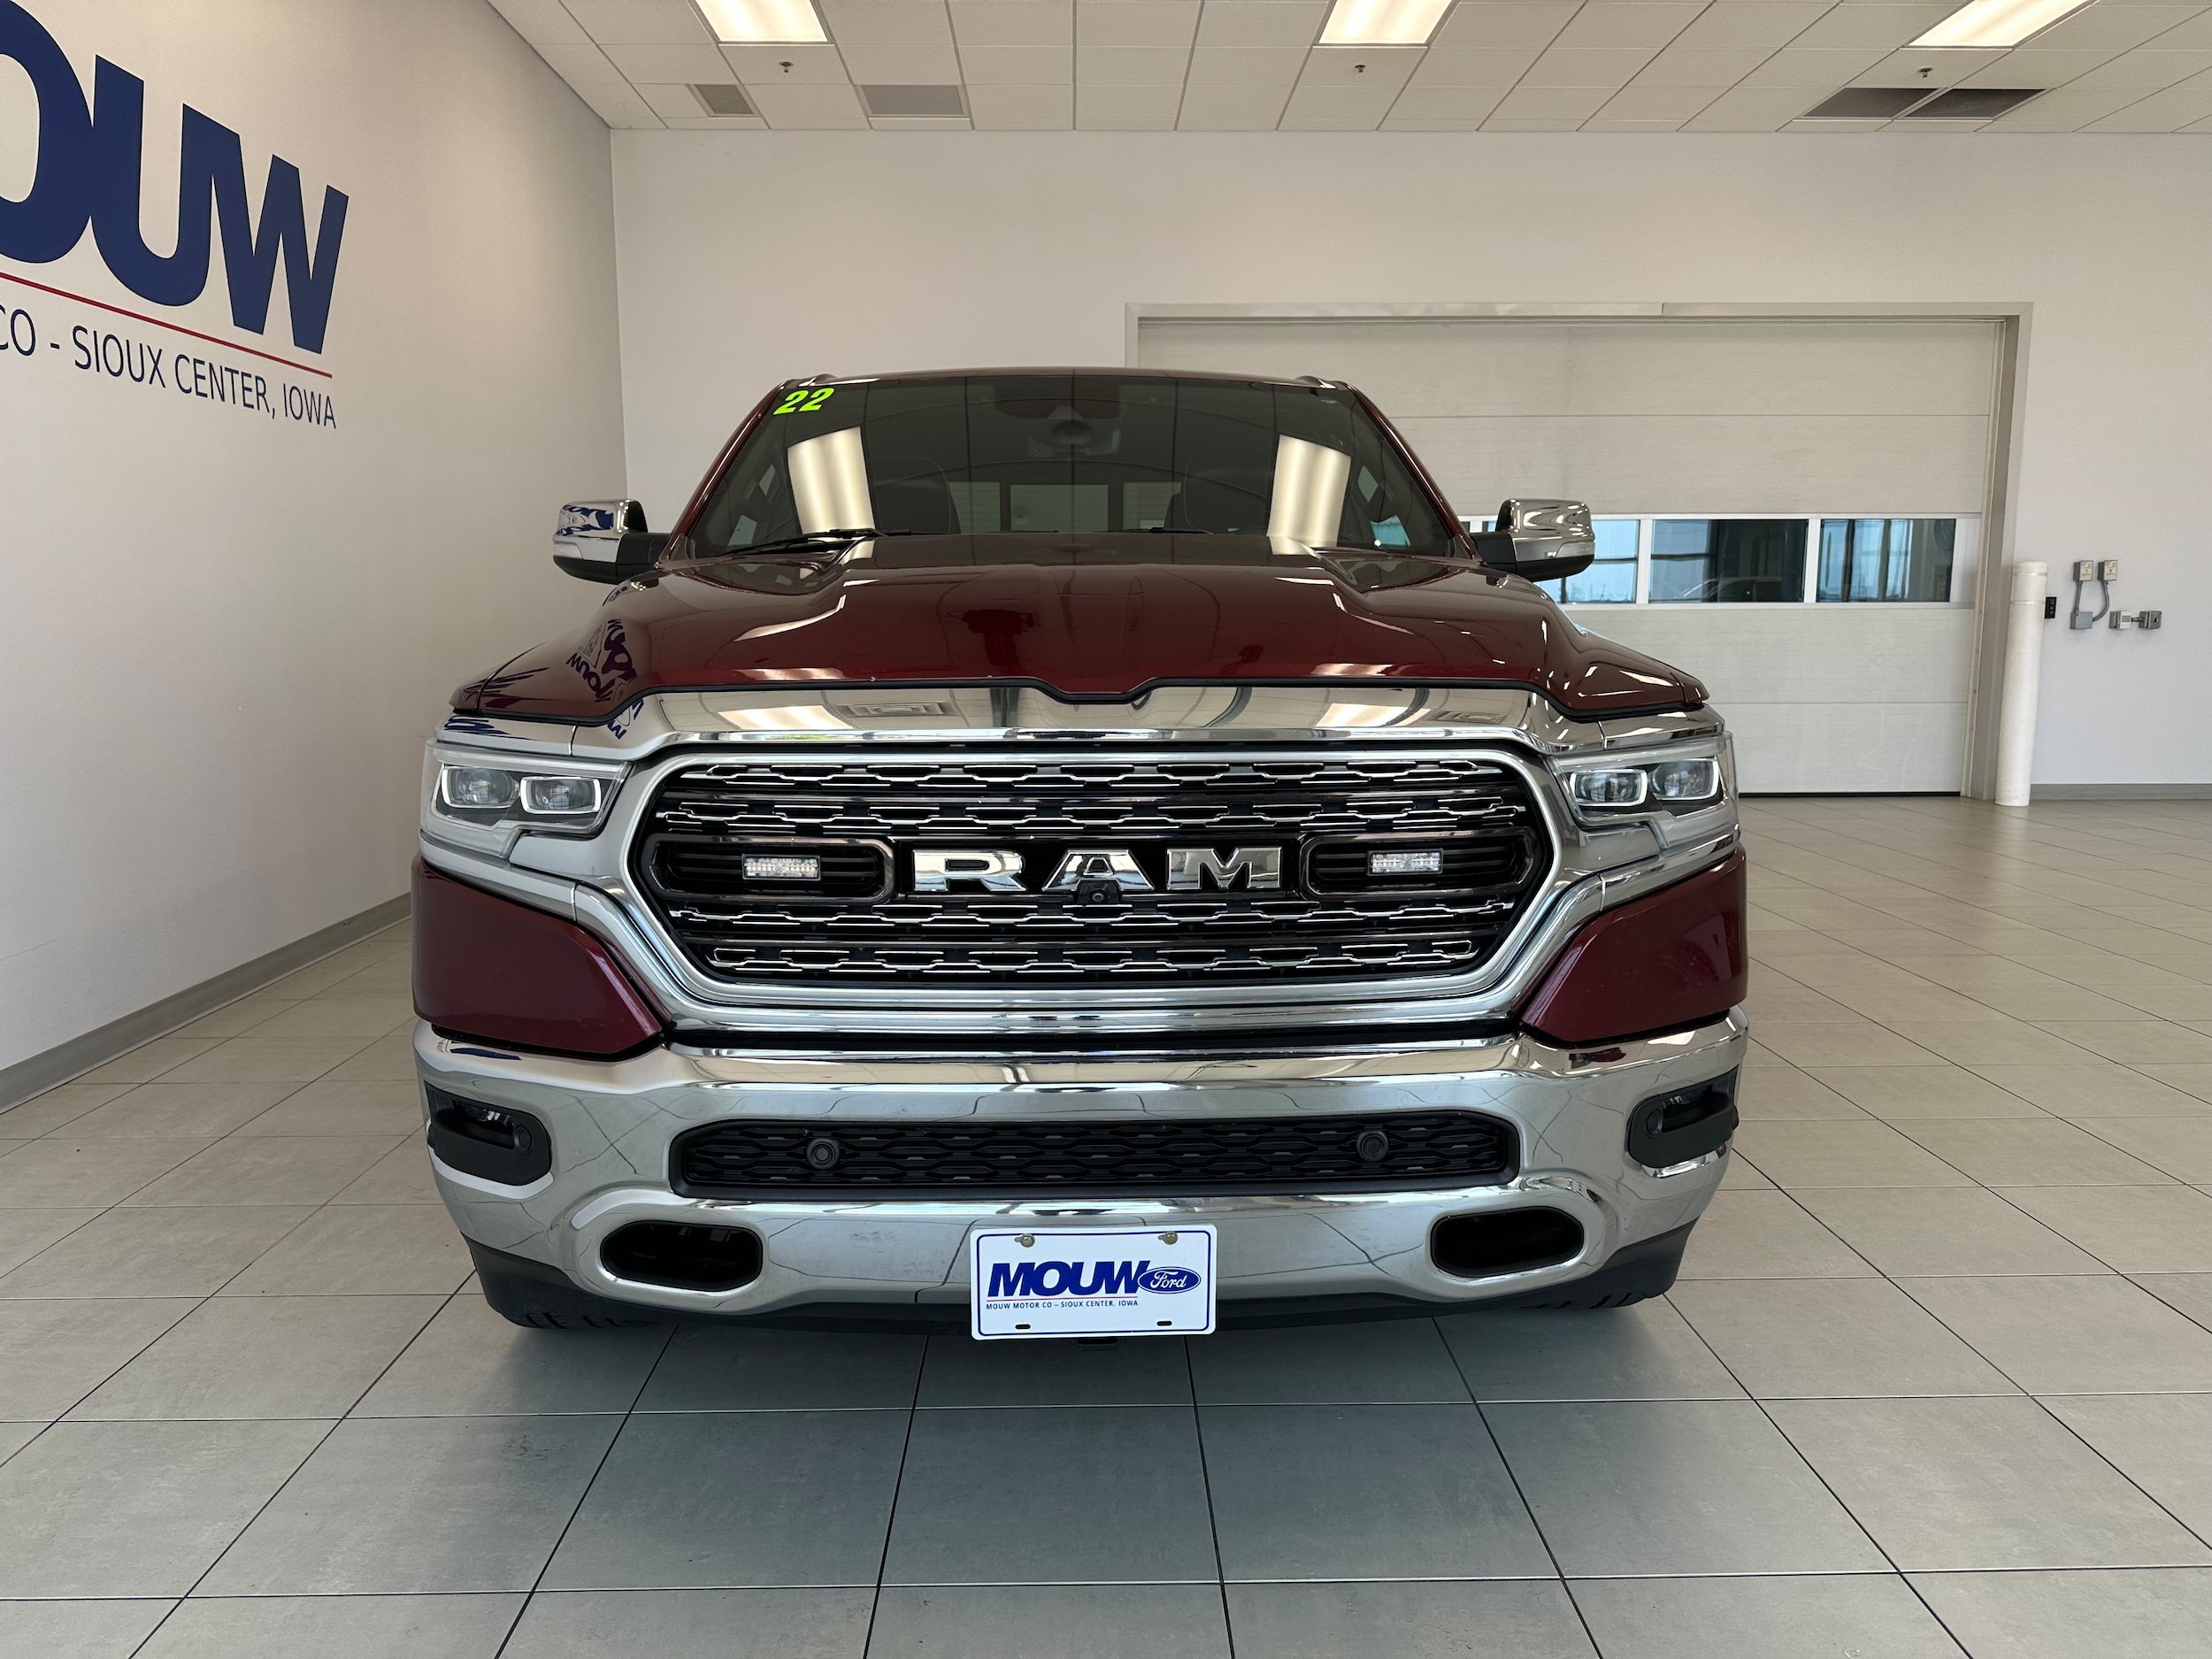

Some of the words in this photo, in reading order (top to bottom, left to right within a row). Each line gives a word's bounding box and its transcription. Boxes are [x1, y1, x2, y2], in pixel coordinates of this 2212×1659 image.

[73, 325, 166, 388] SIOUX
[174, 354, 276, 419] CENTER,
[282, 382, 337, 429] IOWA
[772, 388, 835, 415] 22
[912, 847, 1283, 892] RAM
[987, 1261, 1150, 1297] MOUW
[1150, 1271, 1187, 1289] Ford
